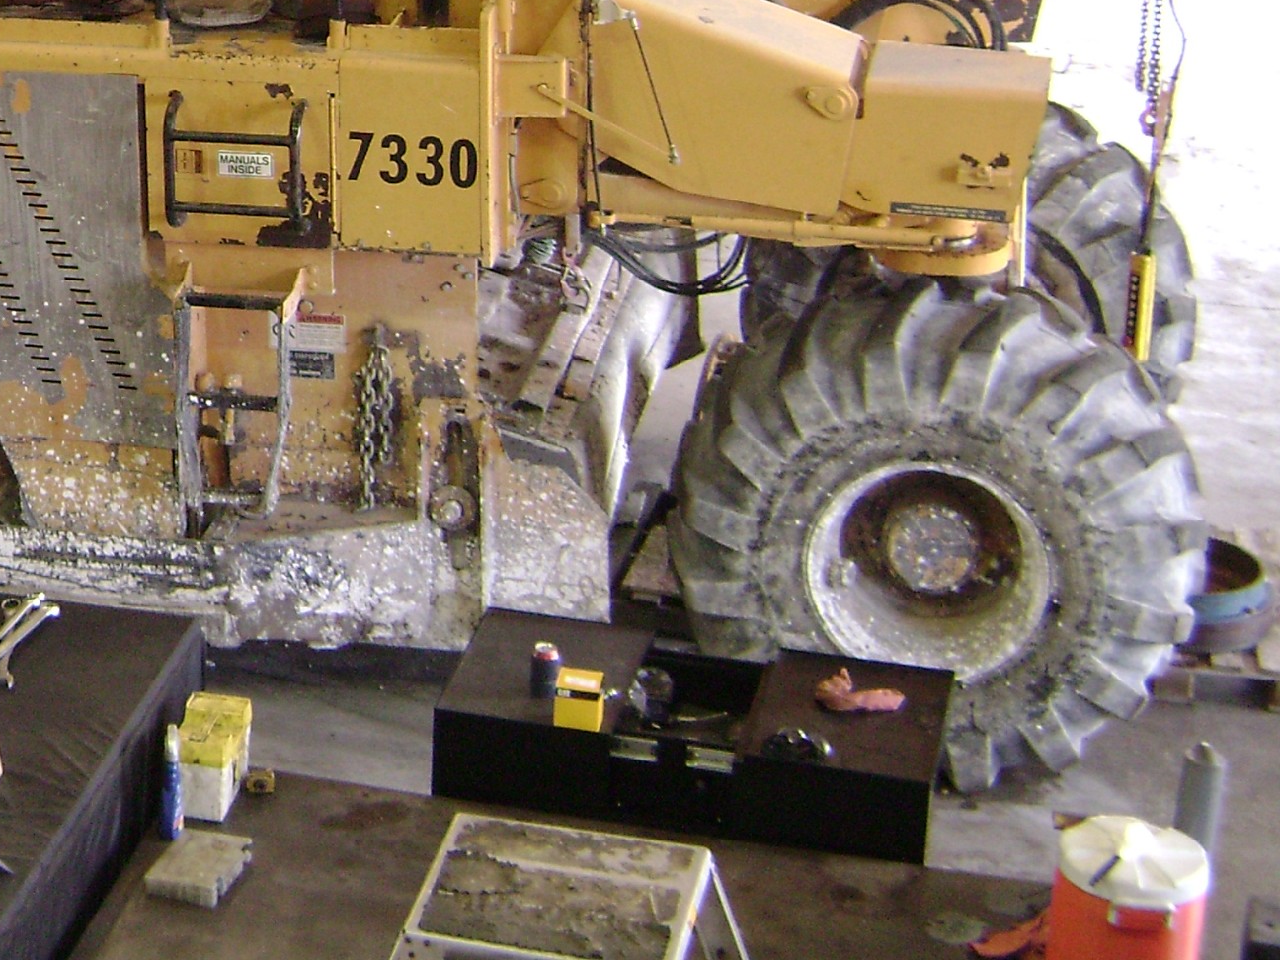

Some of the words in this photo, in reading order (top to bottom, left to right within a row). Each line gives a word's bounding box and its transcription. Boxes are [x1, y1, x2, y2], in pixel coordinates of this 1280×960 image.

[220, 154, 270, 166] MANUALS
[348, 130, 478, 189] 7330
[227, 164, 262, 175] INSIDE
